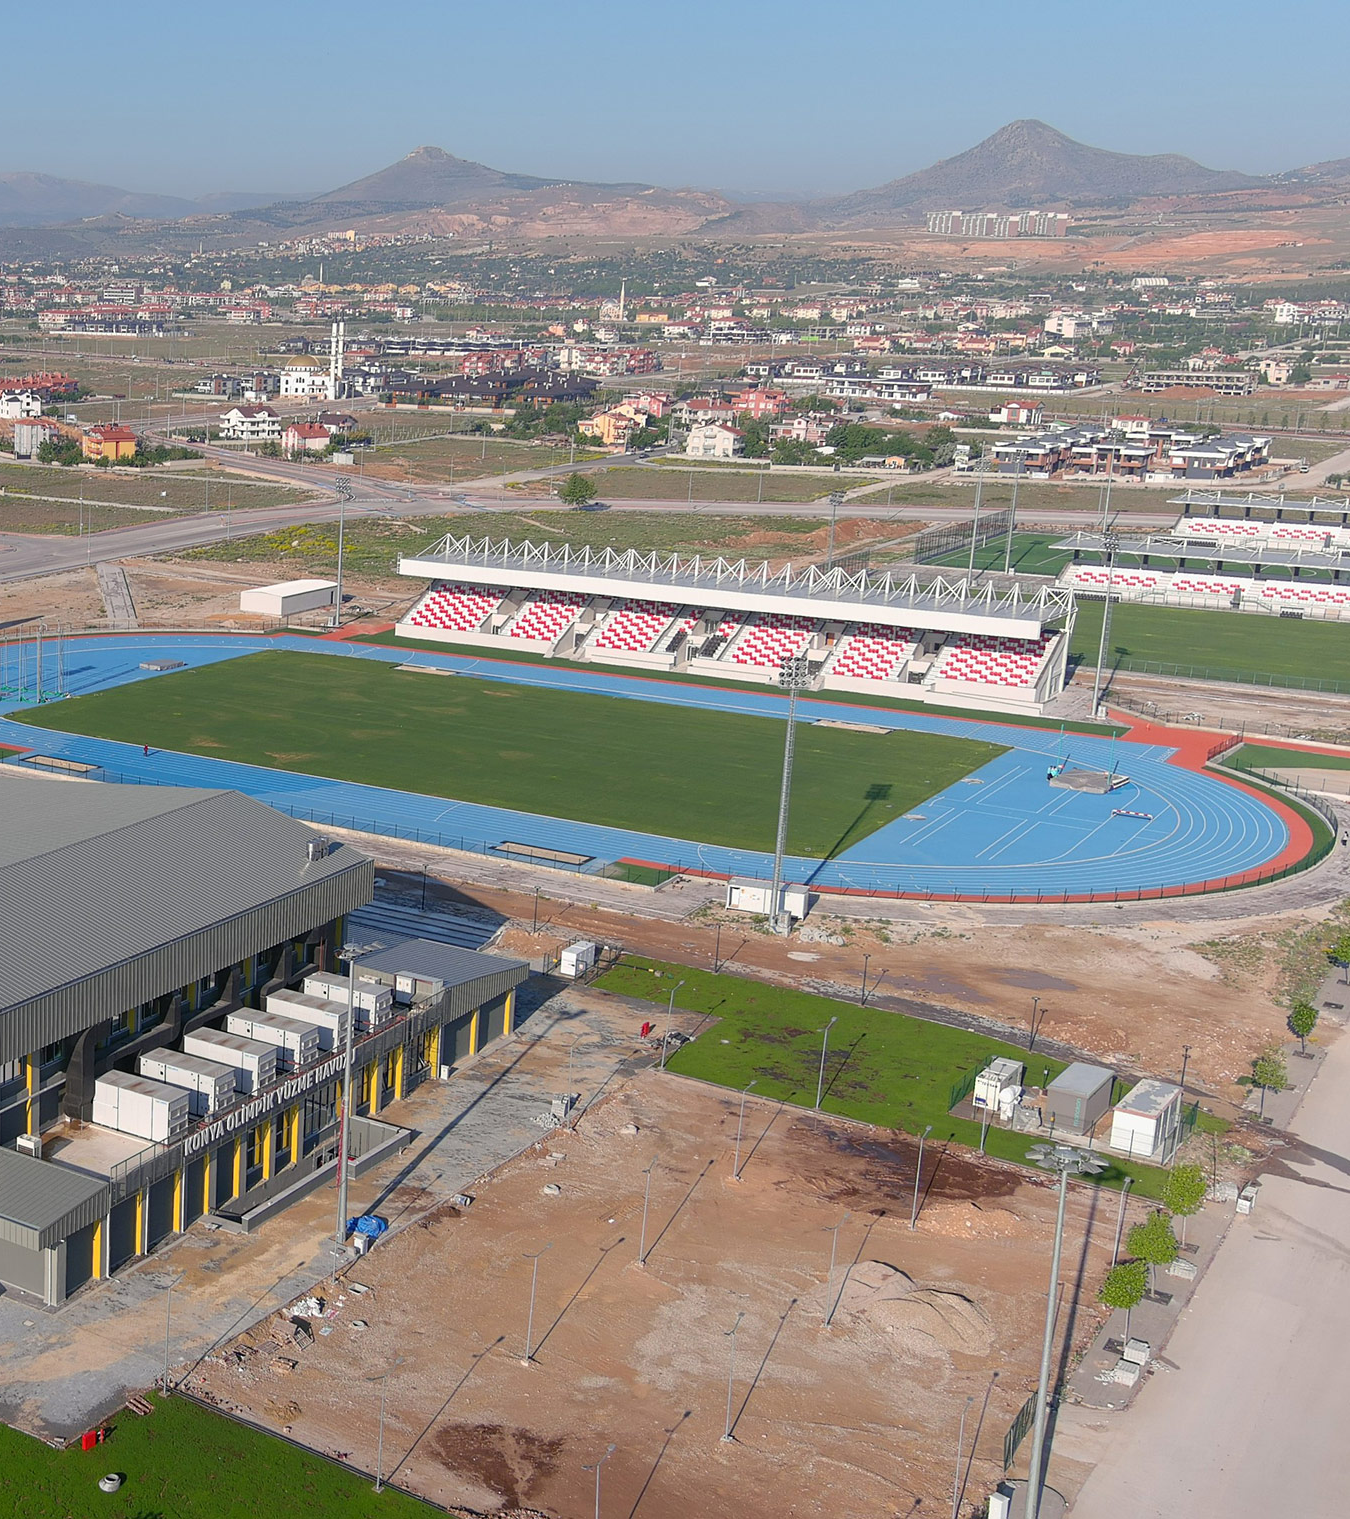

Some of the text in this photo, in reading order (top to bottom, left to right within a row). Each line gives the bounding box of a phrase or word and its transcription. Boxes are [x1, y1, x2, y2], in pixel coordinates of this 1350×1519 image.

[184, 1120, 225, 1156] KONYA
[226, 1091, 275, 1131] OLİMPİK
[276, 1071, 314, 1104] YÜZME
